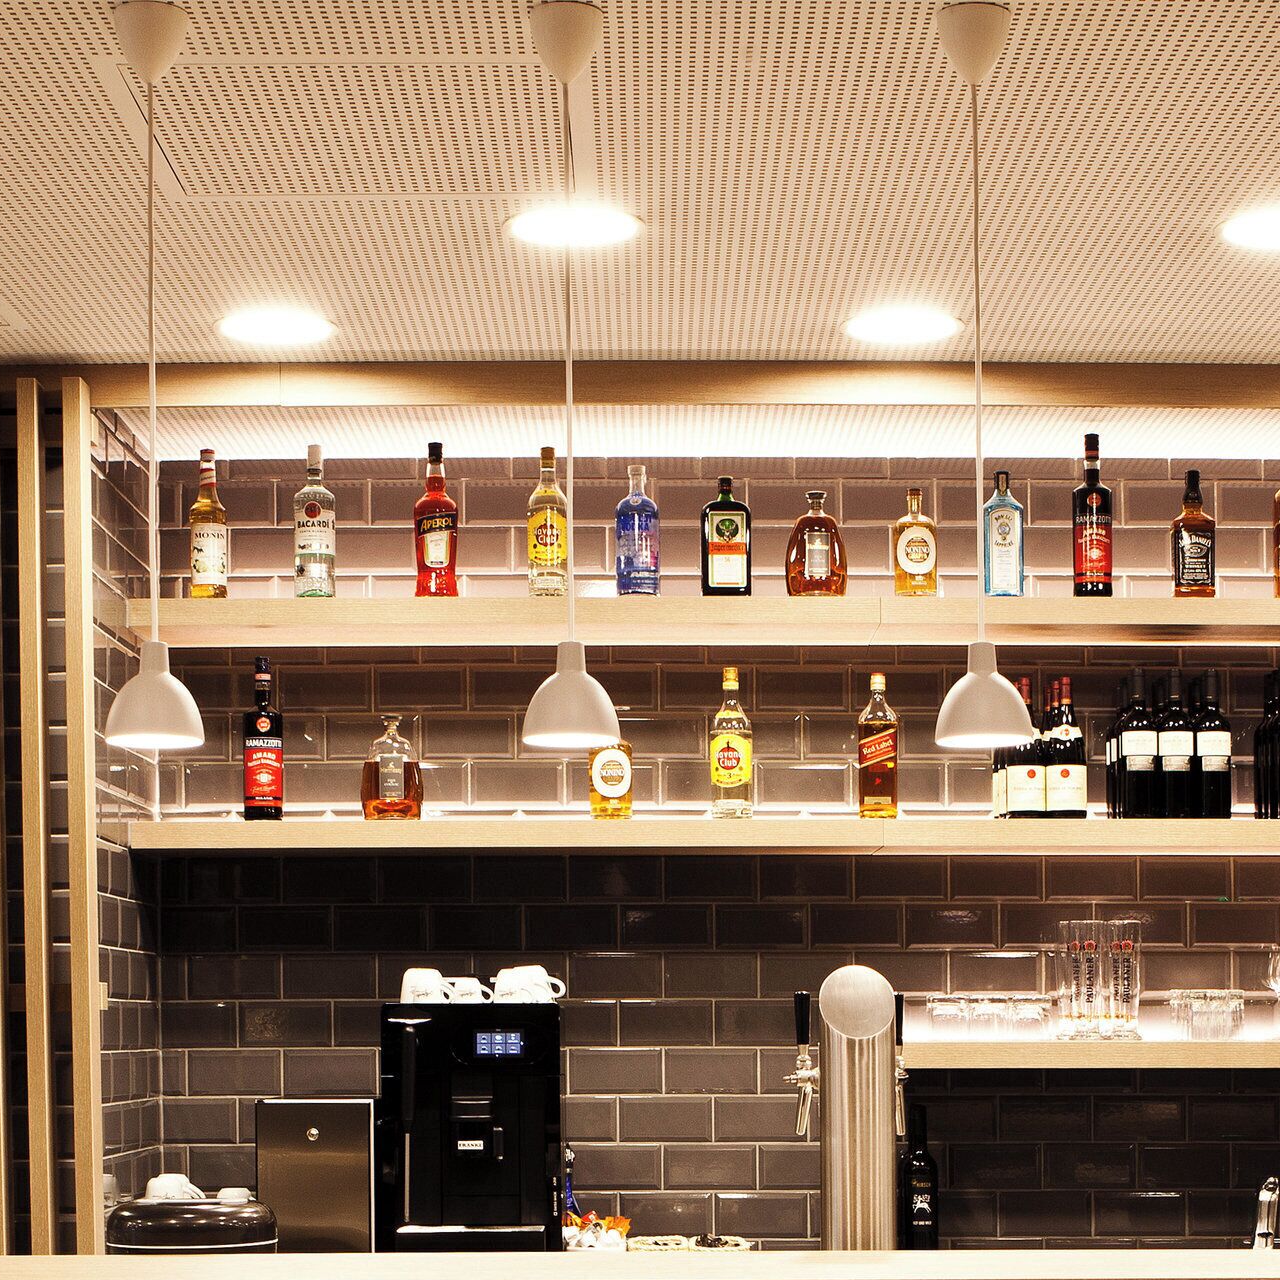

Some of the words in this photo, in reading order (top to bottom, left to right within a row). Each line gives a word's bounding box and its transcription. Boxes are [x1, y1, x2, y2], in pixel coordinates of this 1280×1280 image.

[297, 519, 330, 529] BACARDÍ
[421, 517, 454, 532] APEROL
[194, 531, 225, 540] MONIN
[862, 745, 876, 755] Red
[876, 738, 894, 750] Label
[252, 751, 277, 760] AMARO
[719, 758, 738, 767] Club
[1085, 956, 1095, 1003] PAULANER
[1122, 957, 1131, 1003] PAULANER
